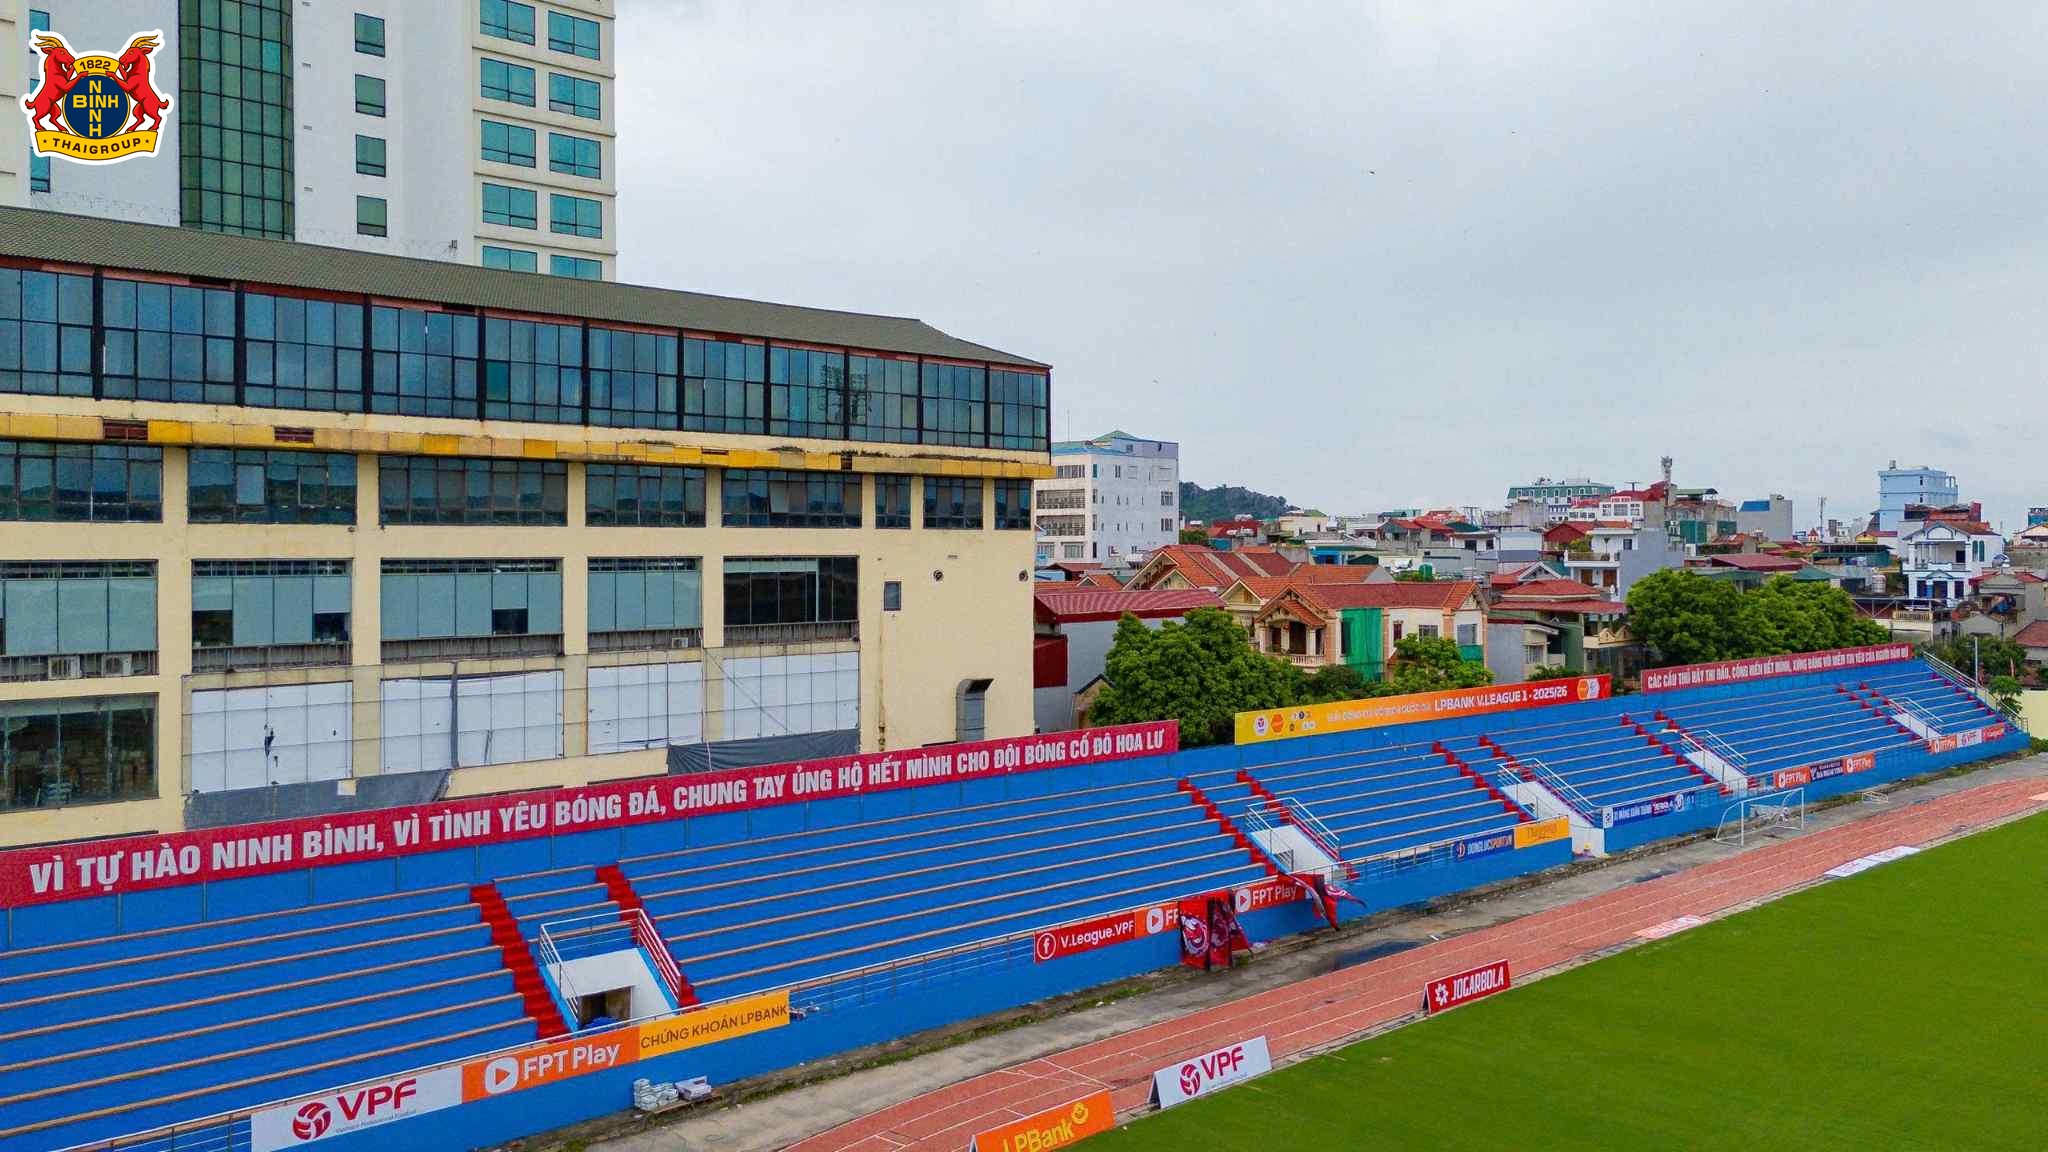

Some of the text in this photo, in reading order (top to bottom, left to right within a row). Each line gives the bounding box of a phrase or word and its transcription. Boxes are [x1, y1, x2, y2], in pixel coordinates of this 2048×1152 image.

[1434, 694, 1474, 712] LPBANK
[1477, 690, 1520, 706] V.LEAGUE
[1532, 685, 1568, 700] 2025/26
[29, 727, 1165, 894] VÌ TỰ HÀO NINH BÌNH, VÌ TÌNH YÊU BÓNG ĐÁ, CHUNG TAY ỦNG HỘ HẾT MÌNH CHO ĐỘI BÓNG CỐ ĐÔ HOA LƯ
[1252, 885, 1297, 905] FPT Play
[1165, 907, 1179, 927] FP
[1060, 920, 1135, 949] V.League.VPF
[1451, 966, 1504, 1001] JOGARBOLA
[641, 1004, 787, 1049] CHỨNG KHOÁN LPBANK
[523, 1043, 620, 1081] FPT Play
[1200, 1046, 1245, 1080] VPF
[337, 1078, 416, 1121] VPF
